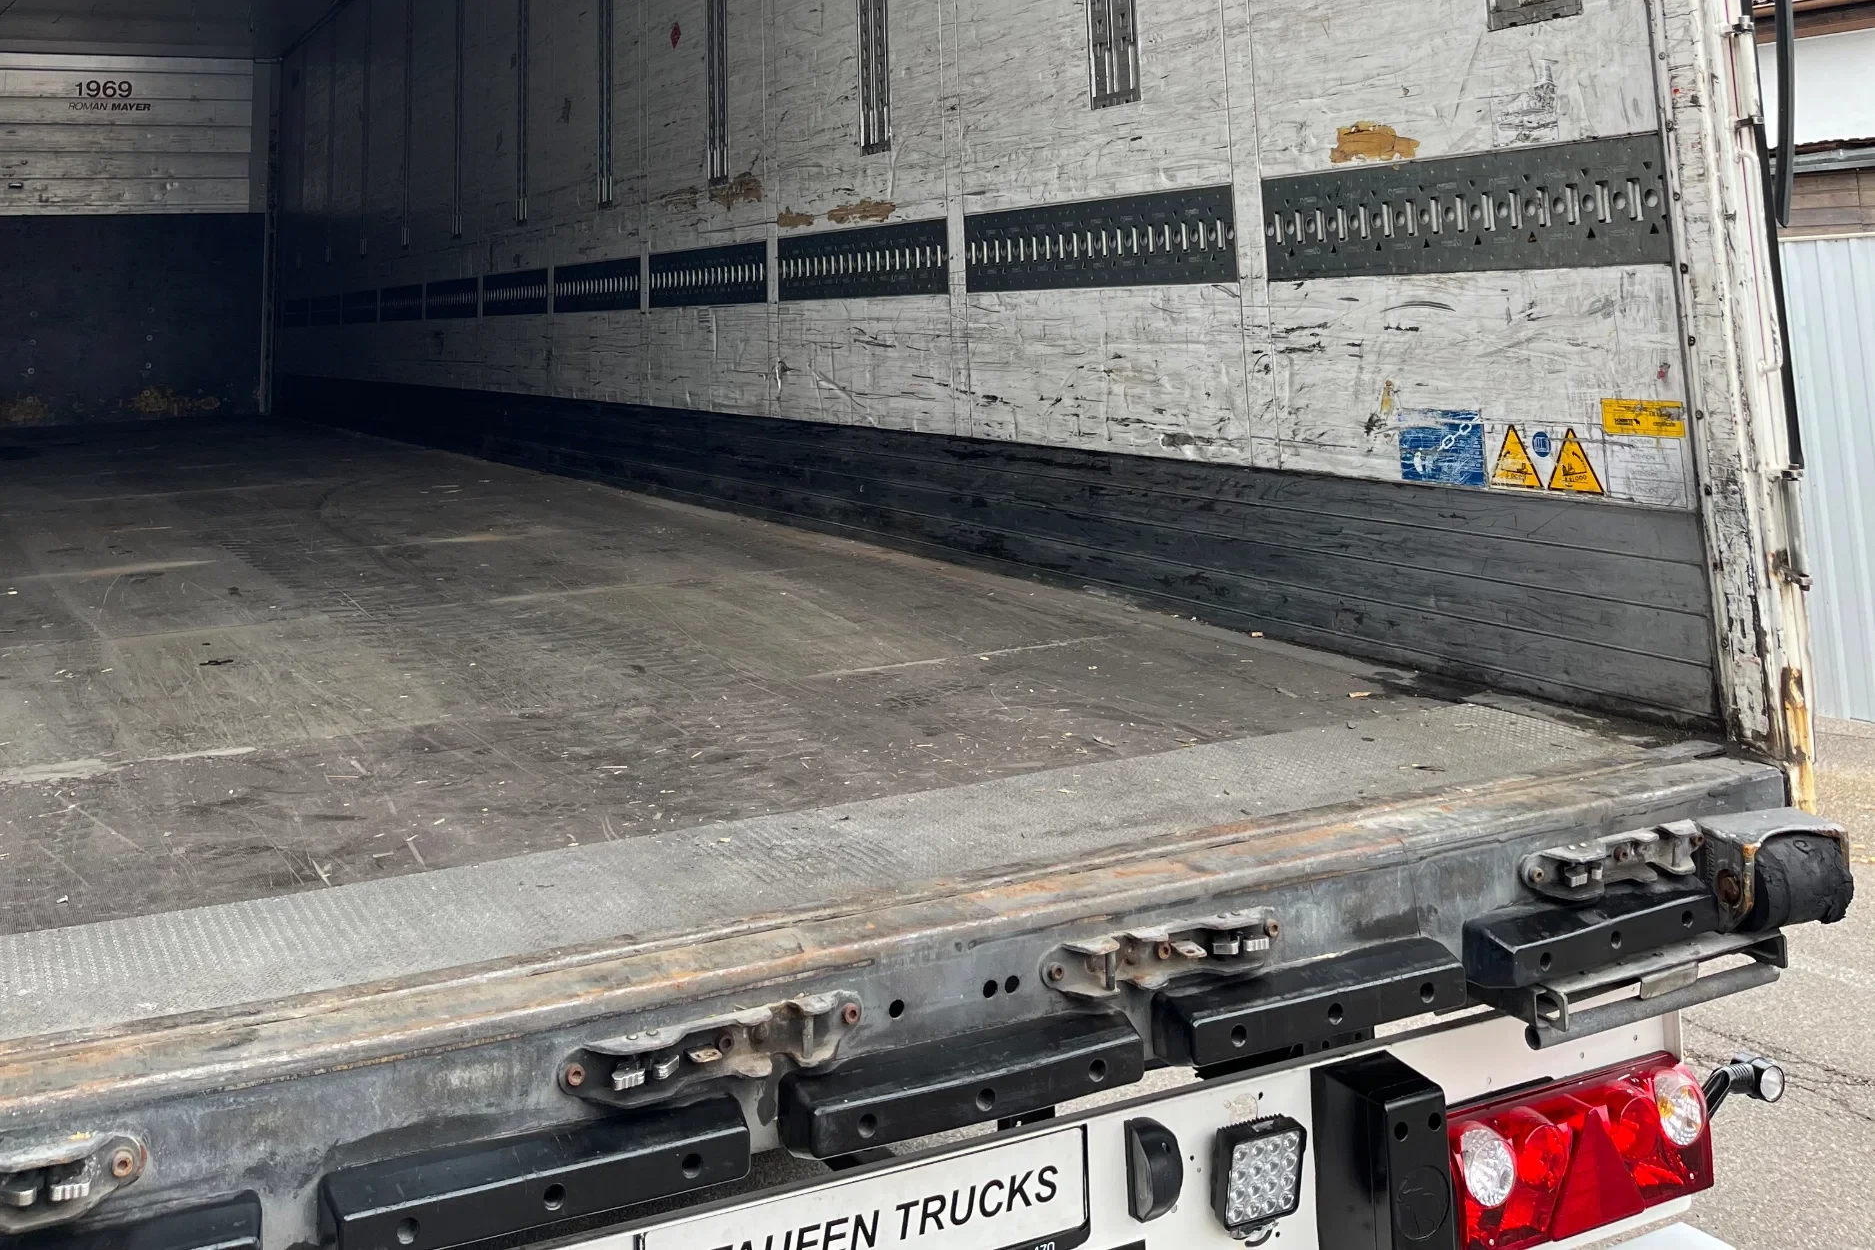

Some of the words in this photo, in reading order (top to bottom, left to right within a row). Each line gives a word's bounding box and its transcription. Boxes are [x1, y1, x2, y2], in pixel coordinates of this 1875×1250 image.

[75, 80, 133, 98] 1969
[68, 101, 108, 111] ROMAN
[111, 103, 152, 111] MAYER
[709, 1209, 880, 1250] FEN
[895, 1165, 1058, 1240] TRUCKS
